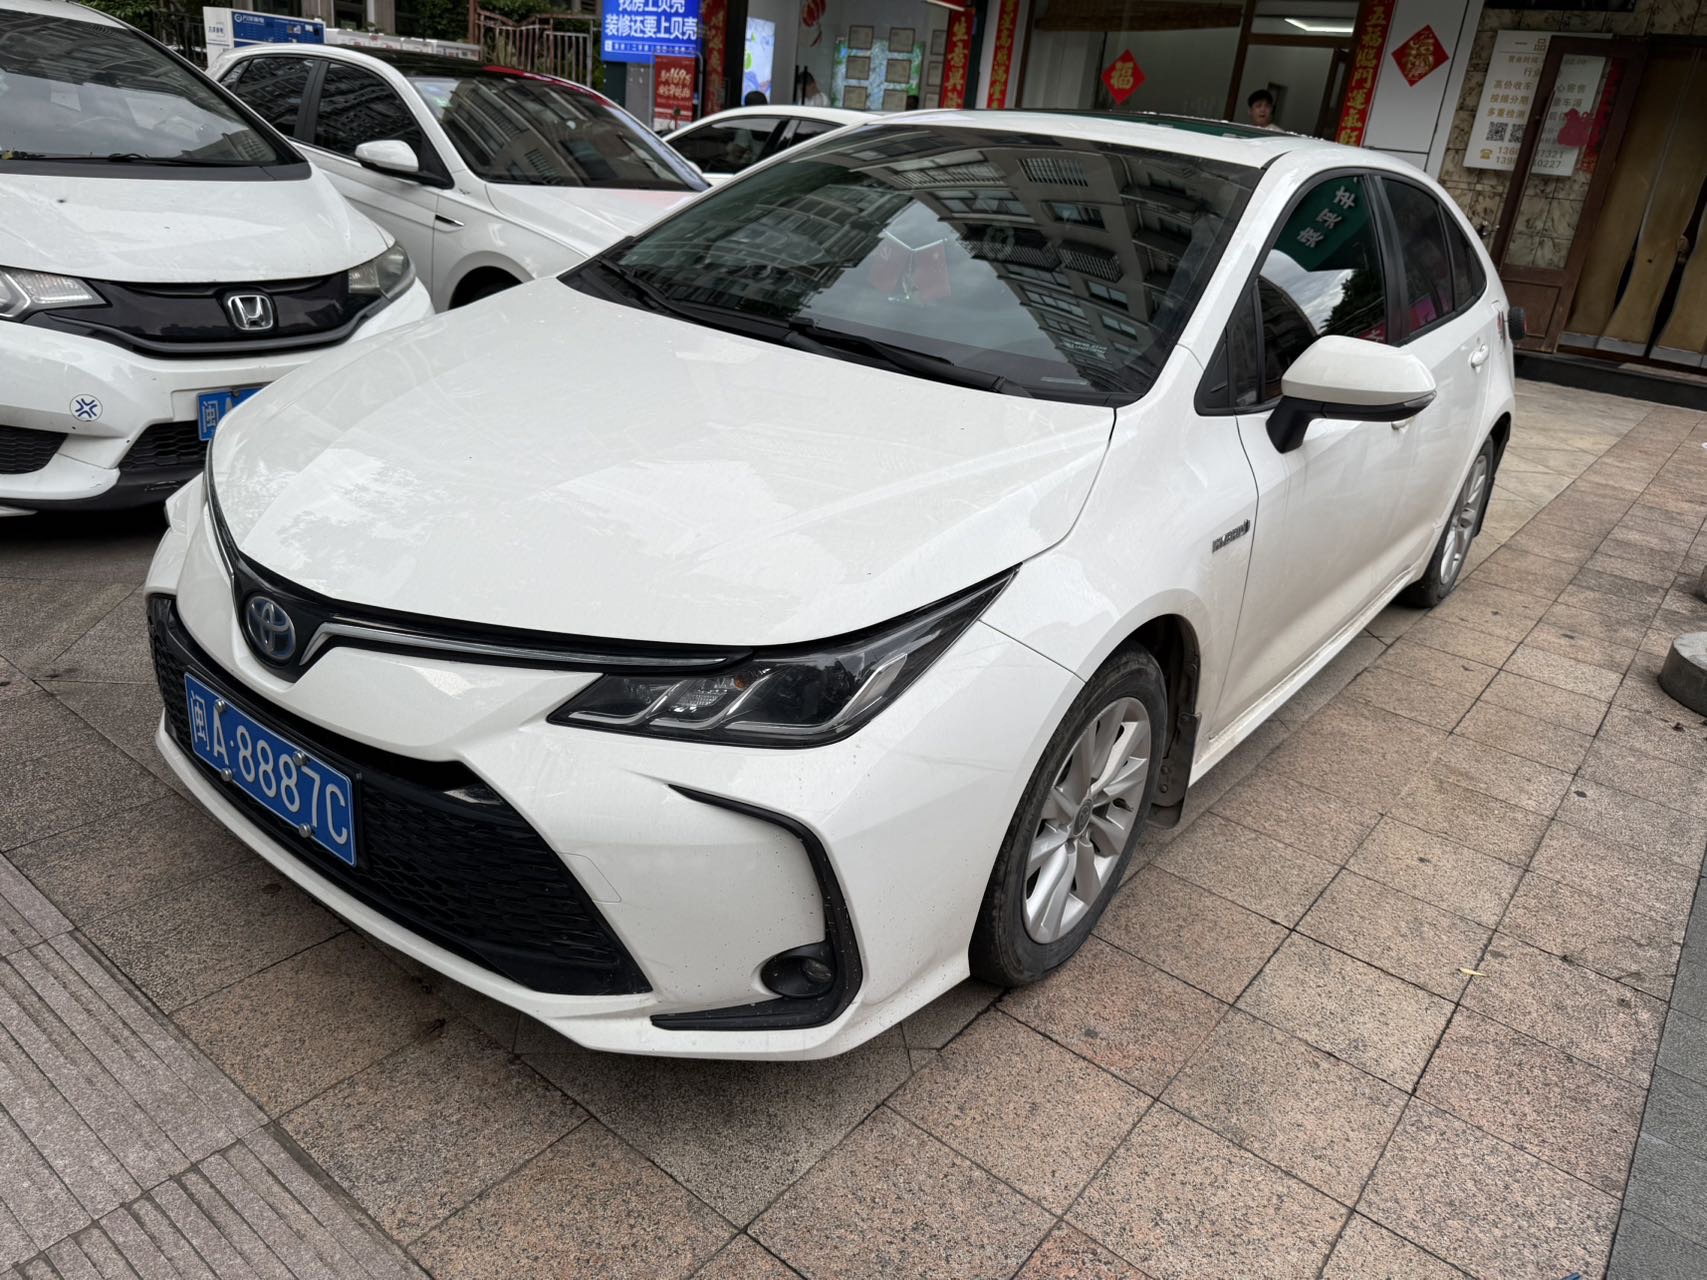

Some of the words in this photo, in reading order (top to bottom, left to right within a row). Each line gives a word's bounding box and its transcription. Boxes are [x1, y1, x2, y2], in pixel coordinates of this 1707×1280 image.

[605, 13, 698, 40] 装修还要上贝壳
[1111, 61, 1134, 89] 福
